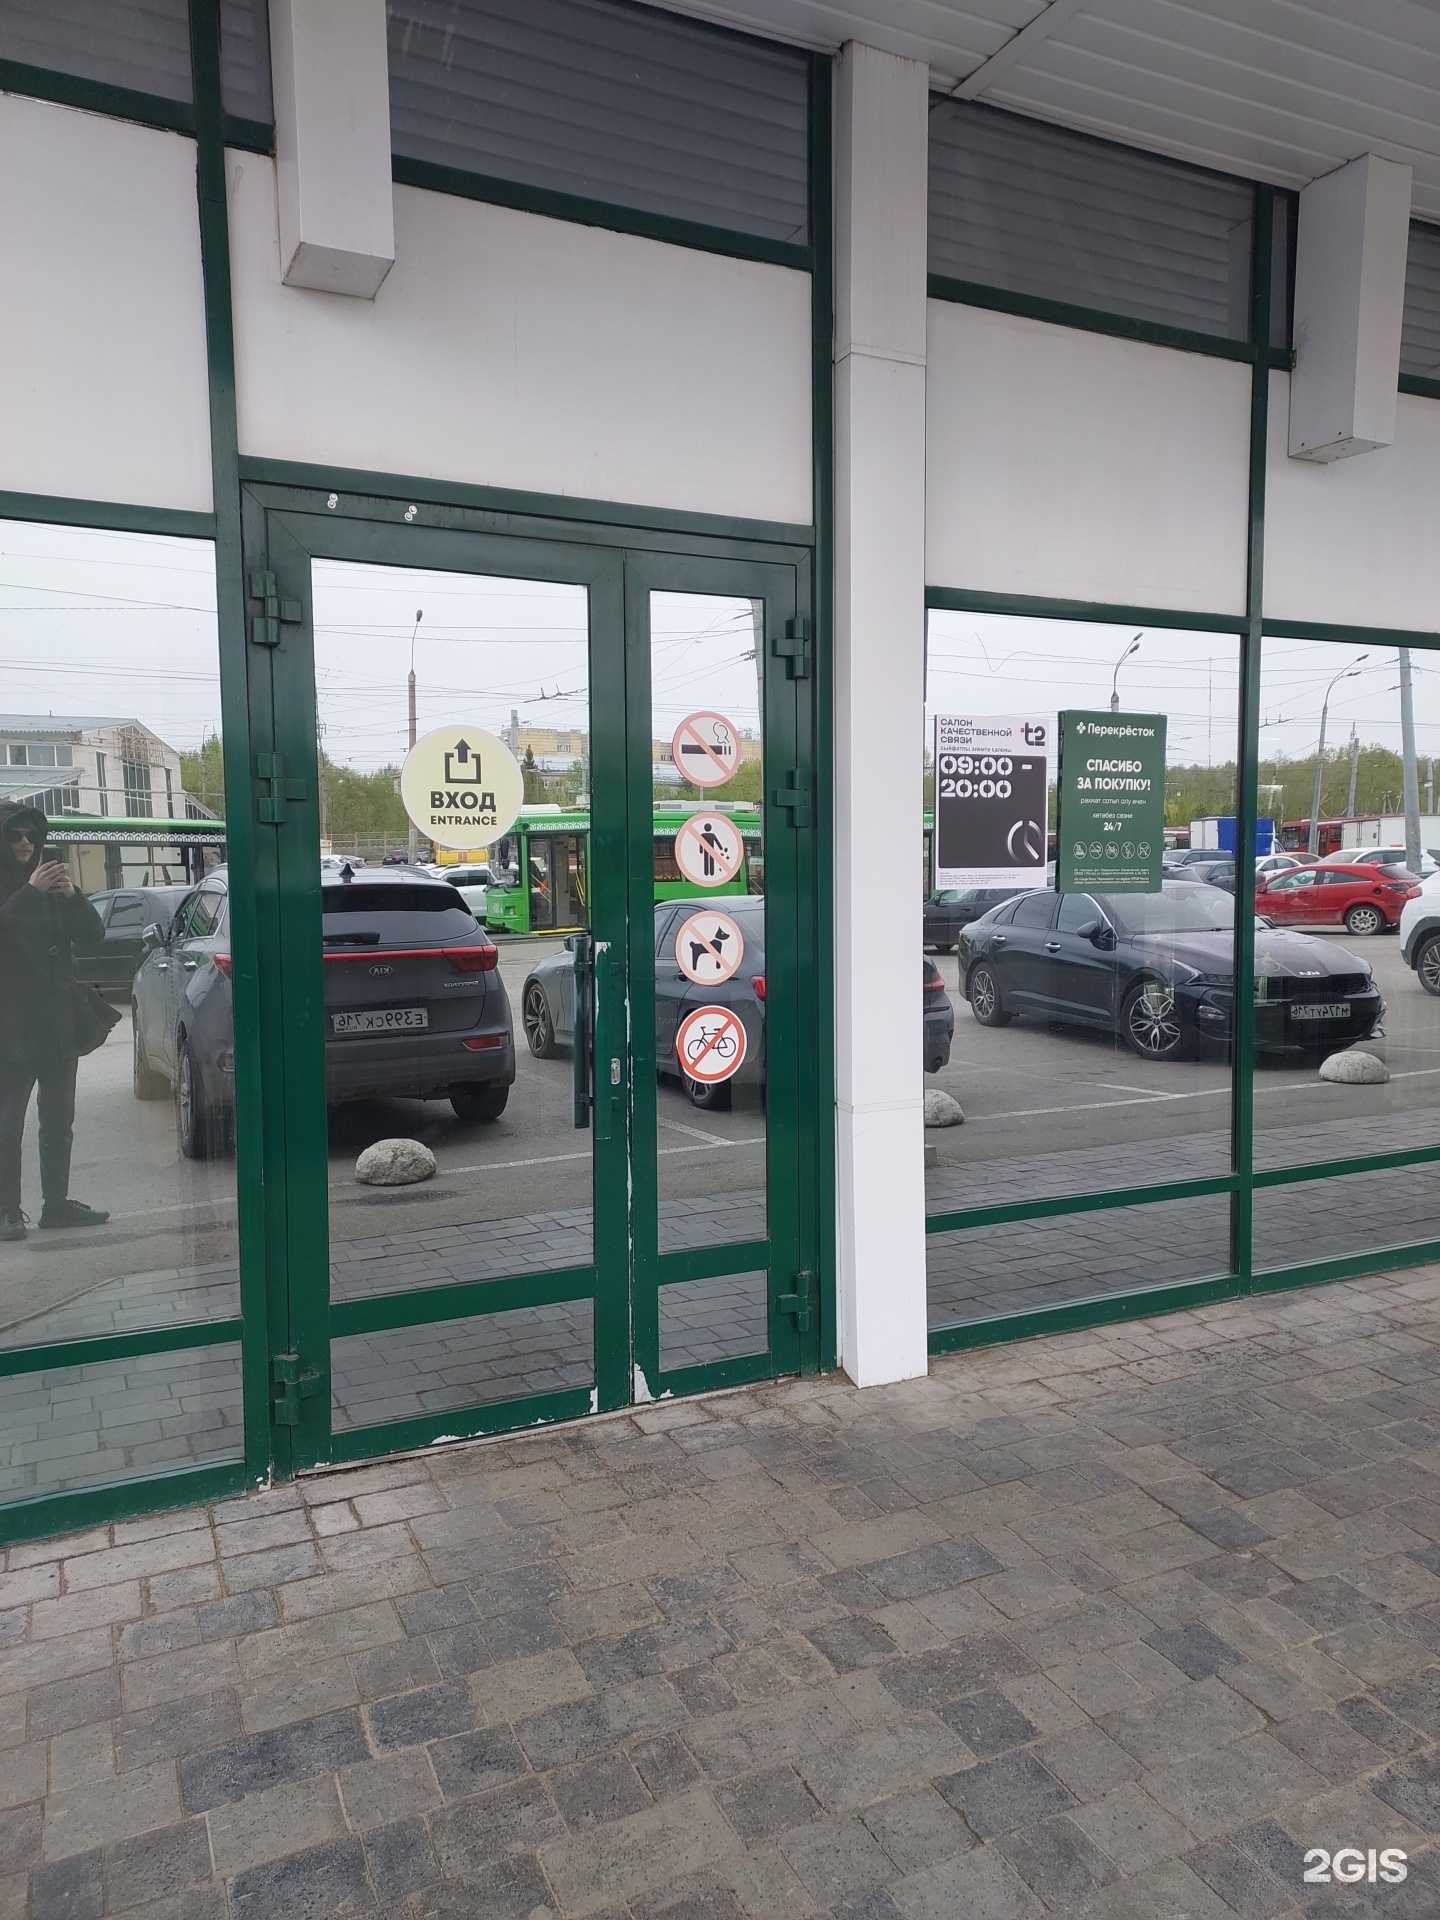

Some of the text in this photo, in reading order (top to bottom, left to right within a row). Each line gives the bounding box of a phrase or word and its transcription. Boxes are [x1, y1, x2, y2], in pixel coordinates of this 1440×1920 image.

[940, 718, 973, 727] САЛОН
[940, 727, 1013, 737] КАЧЕСТВЕННОЙ
[1024, 722, 1046, 746] t2
[1087, 722, 1155, 738] Перекрёсток
[940, 736, 973, 745] СВЯЗИ
[940, 755, 1013, 776] 09:00
[1086, 758, 1142, 773] СПАСИБО
[940, 778, 1012, 798] 20:00
[1077, 777, 1152, 791] ЗА ПОКУПКУ!
[430, 791, 497, 813] ВХОД
[430, 815, 497, 825] ENTRANCE
[1103, 821, 1122, 832] 24/7
